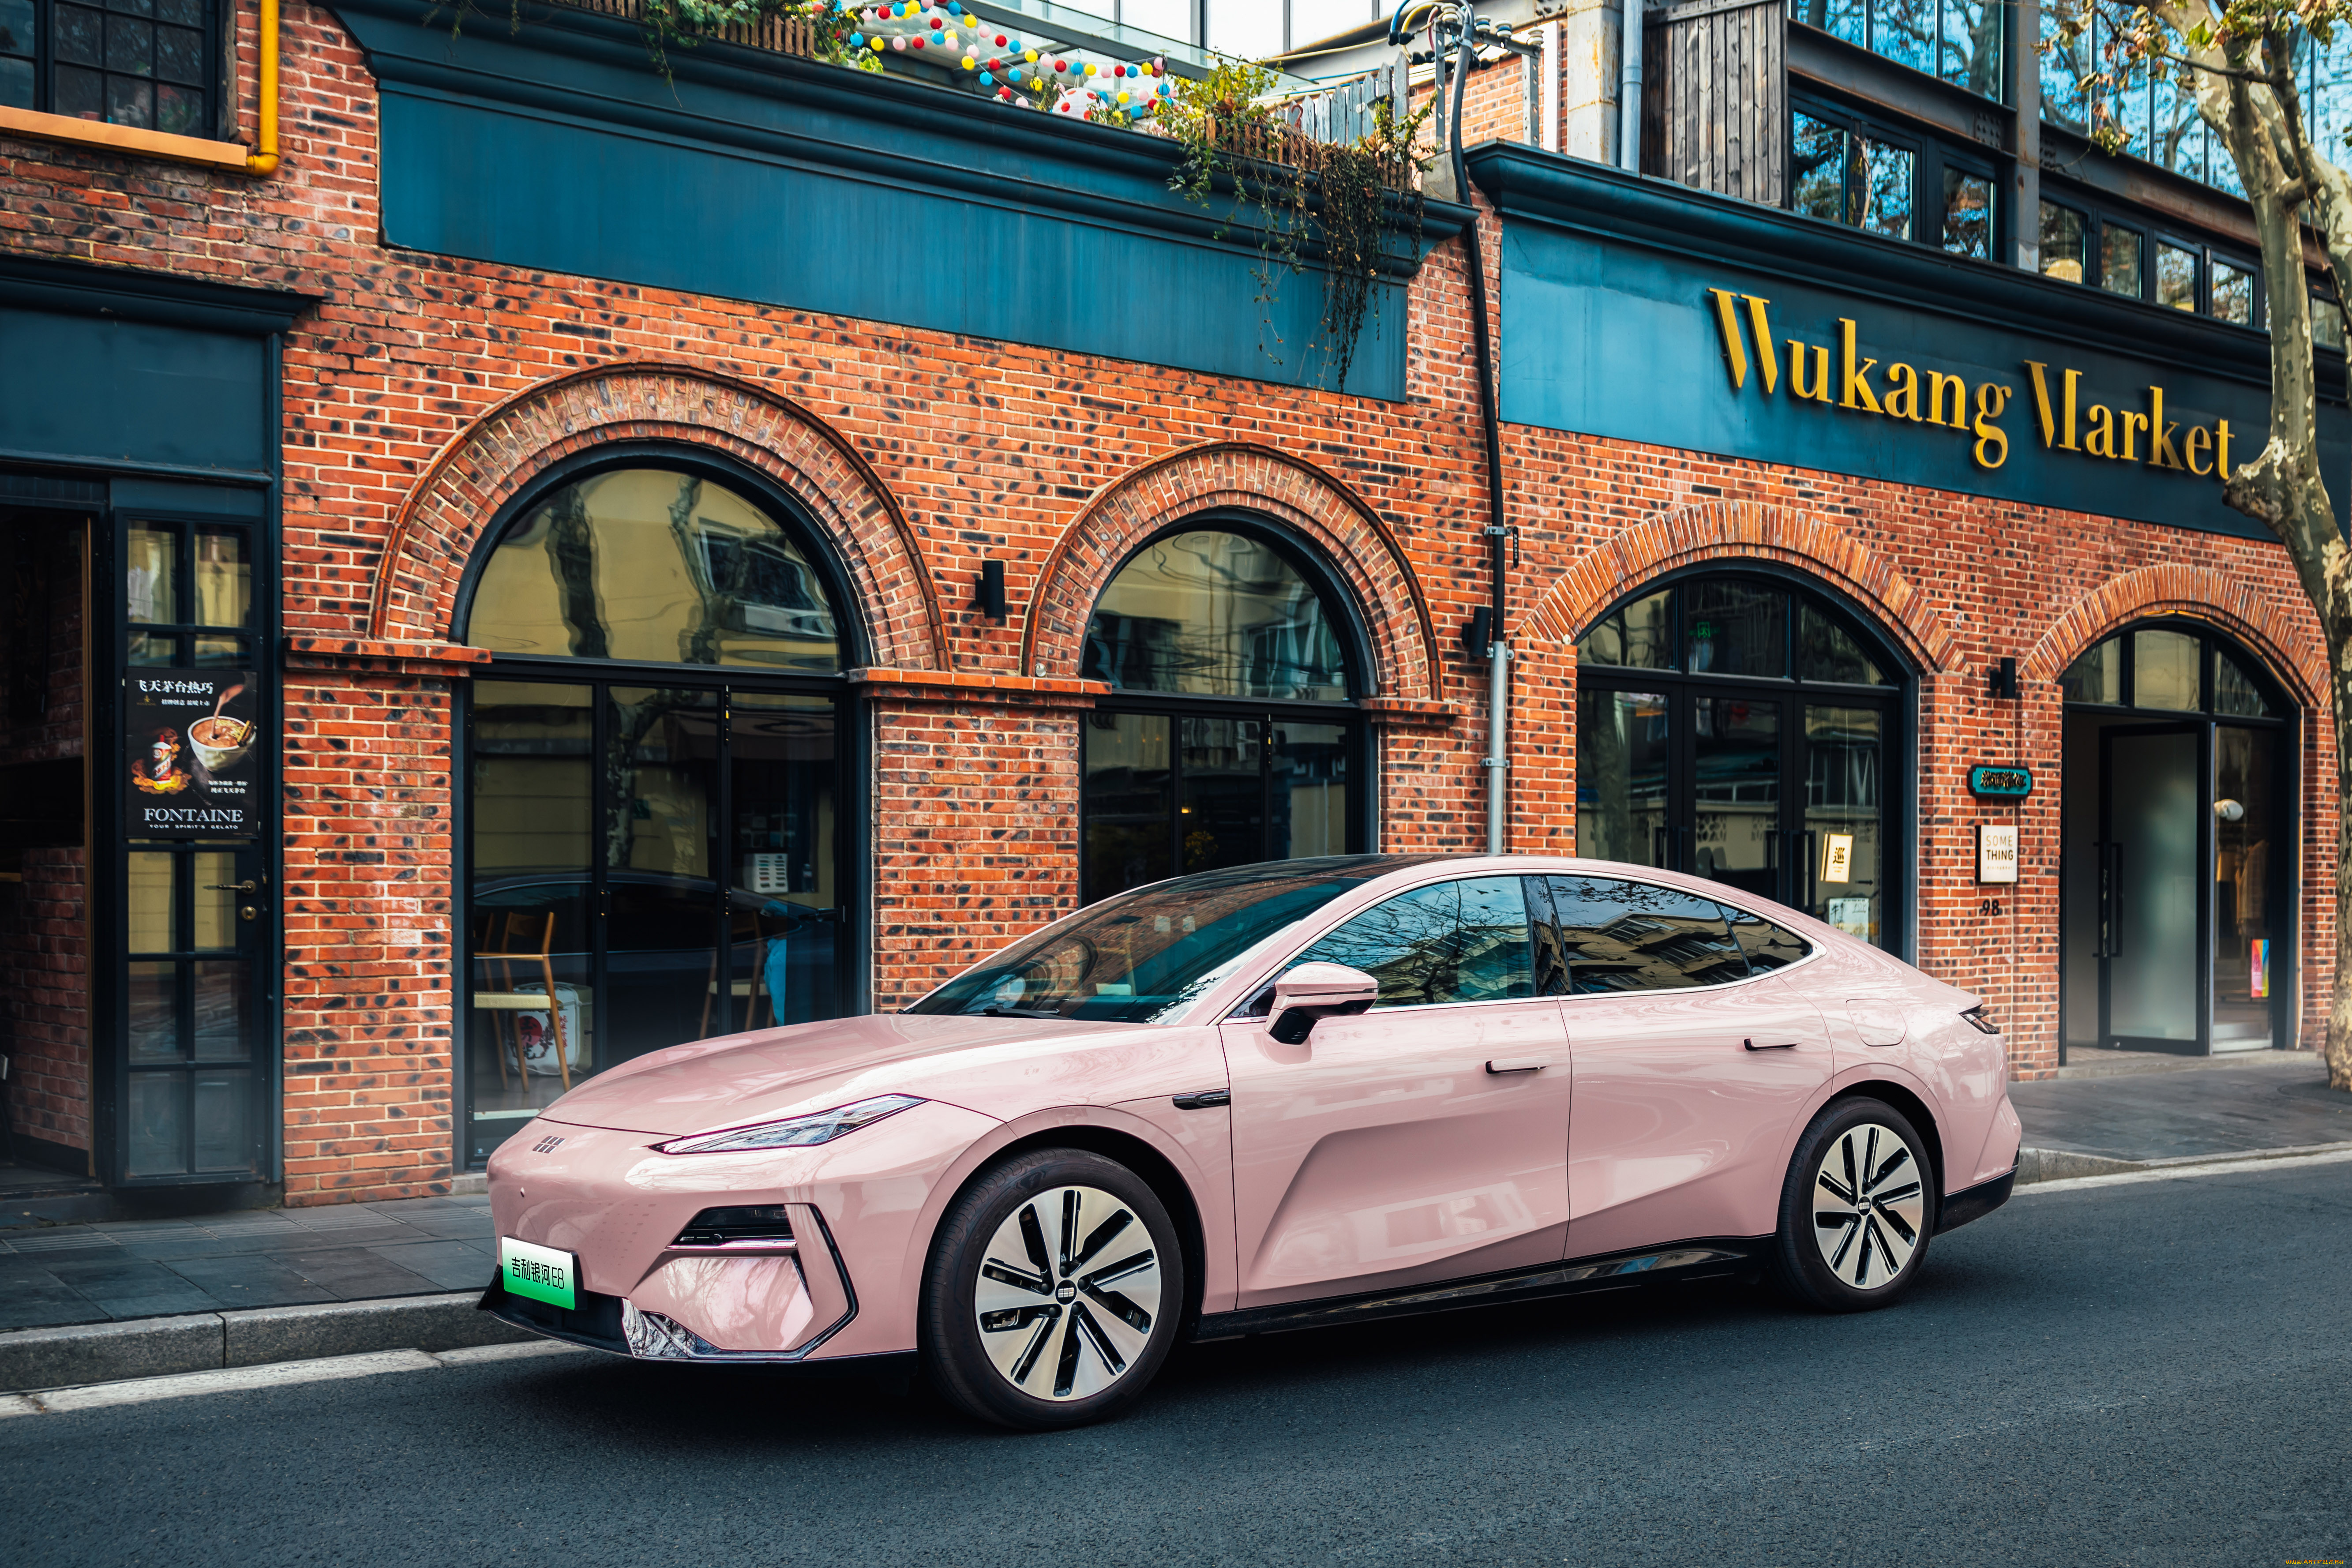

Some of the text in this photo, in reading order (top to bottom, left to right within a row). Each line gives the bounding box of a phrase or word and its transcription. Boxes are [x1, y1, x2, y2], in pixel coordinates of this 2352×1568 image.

[1706, 288, 2236, 480] Wukang Market
[135, 679, 214, 695] 飞天茅台热巧
[143, 808, 244, 822] FONTAINE
[1986, 835, 2013, 847] SOME
[1833, 847, 1845, 864] 巡
[1986, 849, 2014, 860] THING
[1982, 899, 1999, 916] 98
[511, 1257, 564, 1290] 吉利银河E8
